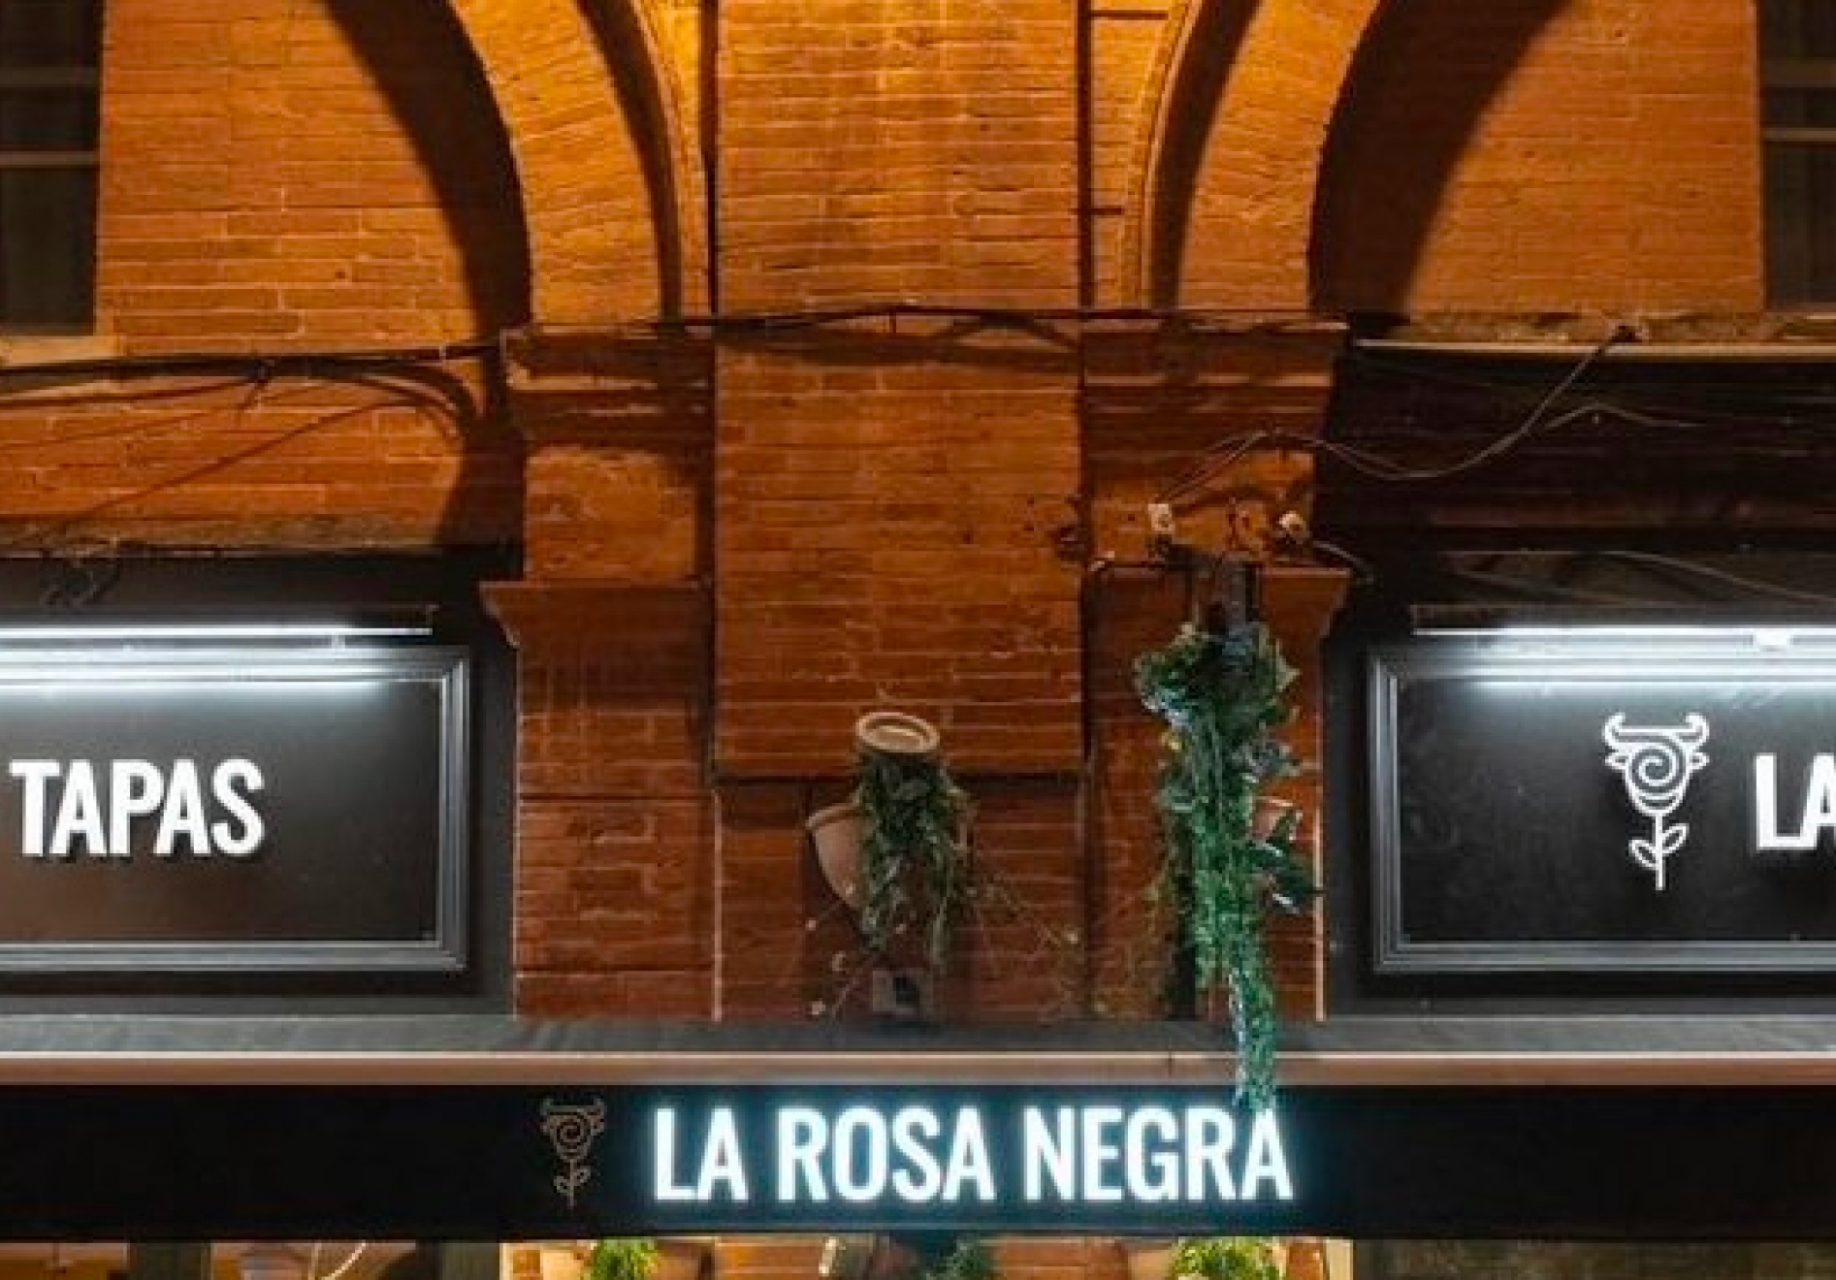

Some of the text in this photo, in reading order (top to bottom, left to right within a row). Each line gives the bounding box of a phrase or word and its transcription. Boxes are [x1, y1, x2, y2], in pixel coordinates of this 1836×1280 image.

[9, 758, 266, 857] TAPAS
[1755, 753, 1836, 850] LA
[653, 1105, 1295, 1203] LA ROSA NEGRA
